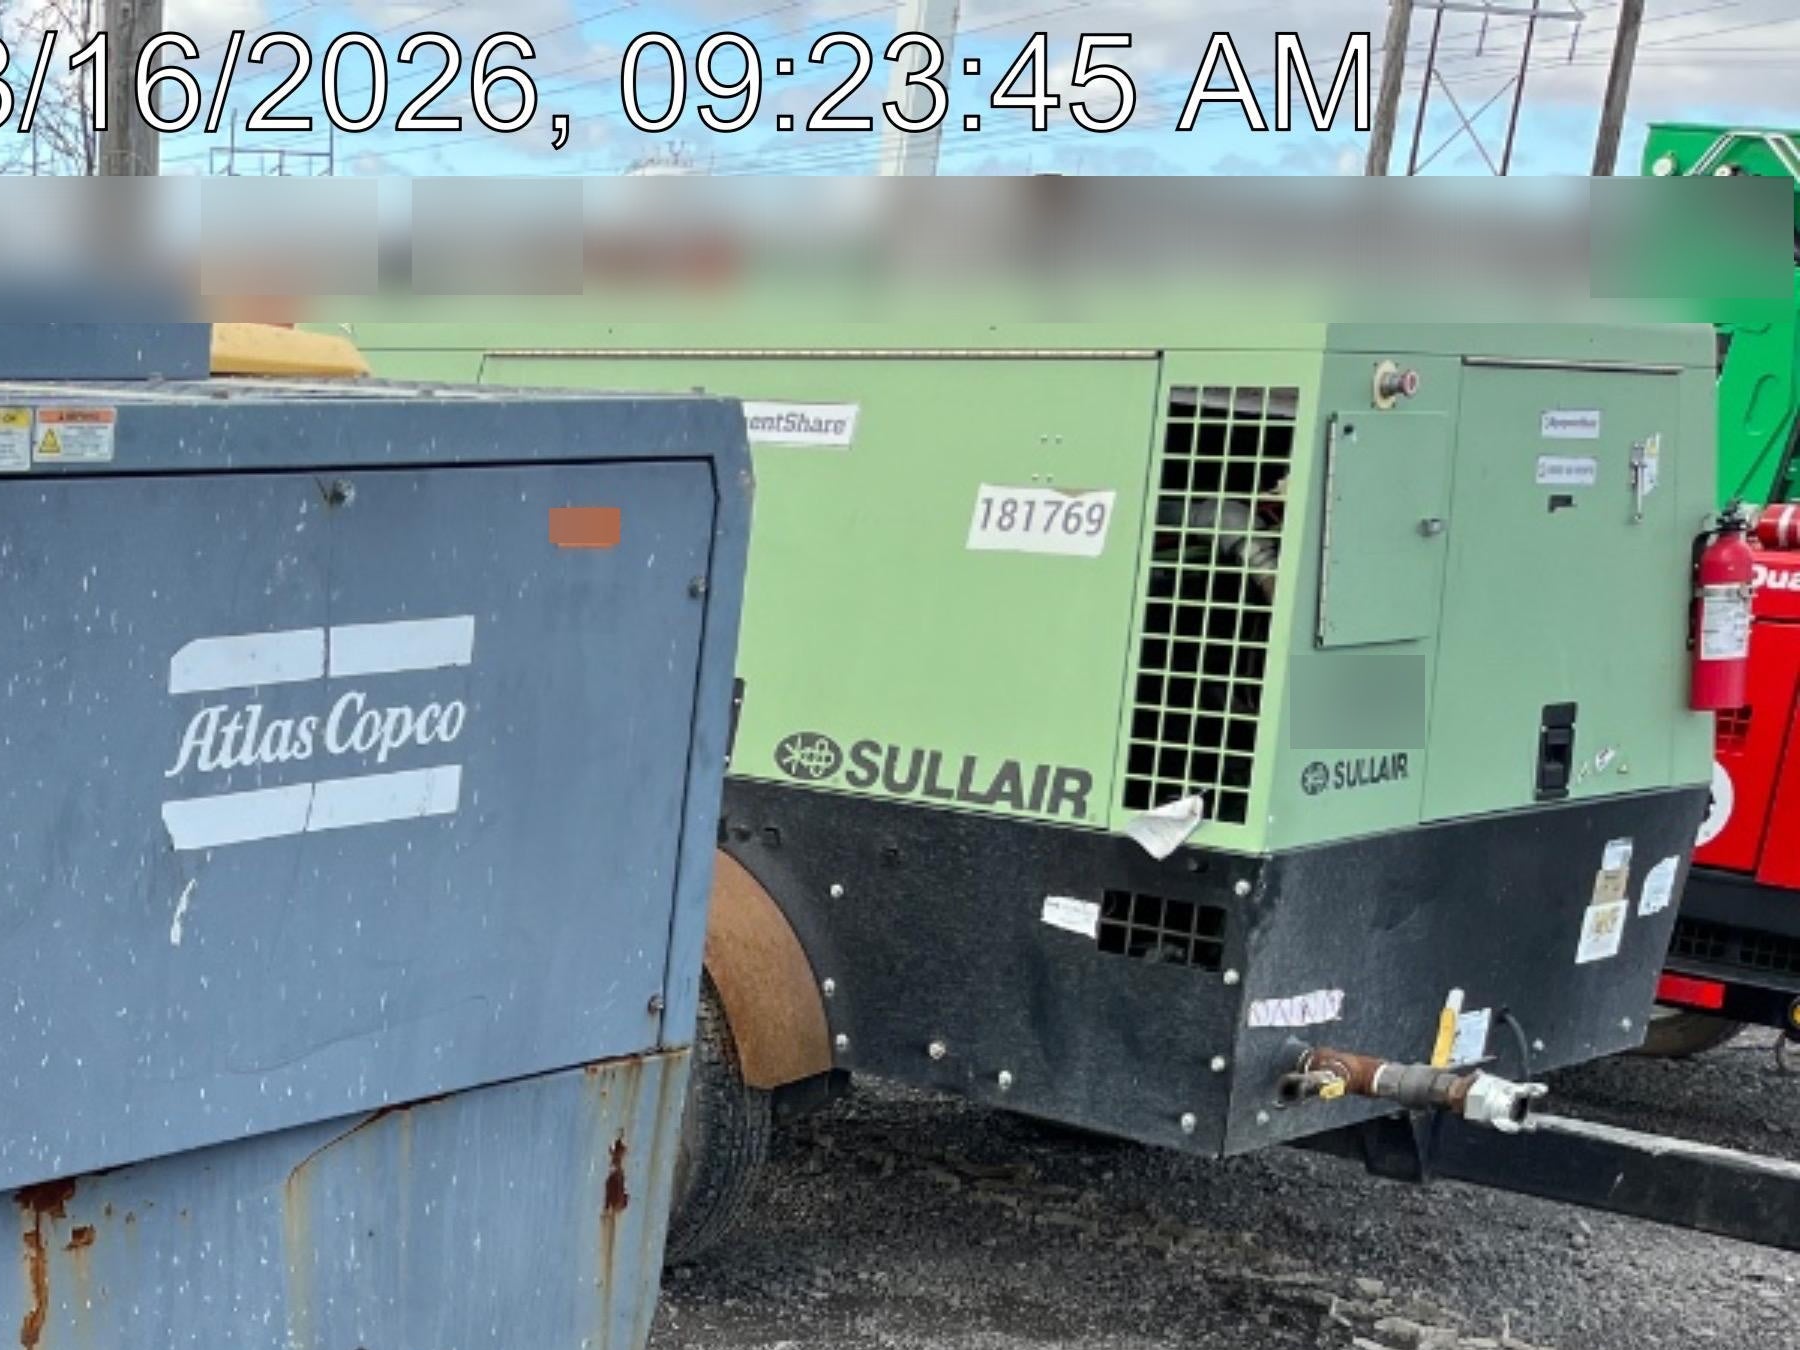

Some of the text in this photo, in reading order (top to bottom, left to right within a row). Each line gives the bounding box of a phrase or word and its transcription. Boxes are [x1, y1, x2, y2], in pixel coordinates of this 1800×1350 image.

[746, 412, 847, 436] entShare
[980, 497, 1106, 536] 181769
[164, 691, 466, 778] Atlas Copco
[845, 739, 1094, 819] SULLAIR
[1332, 752, 1408, 790] SULLAIR
